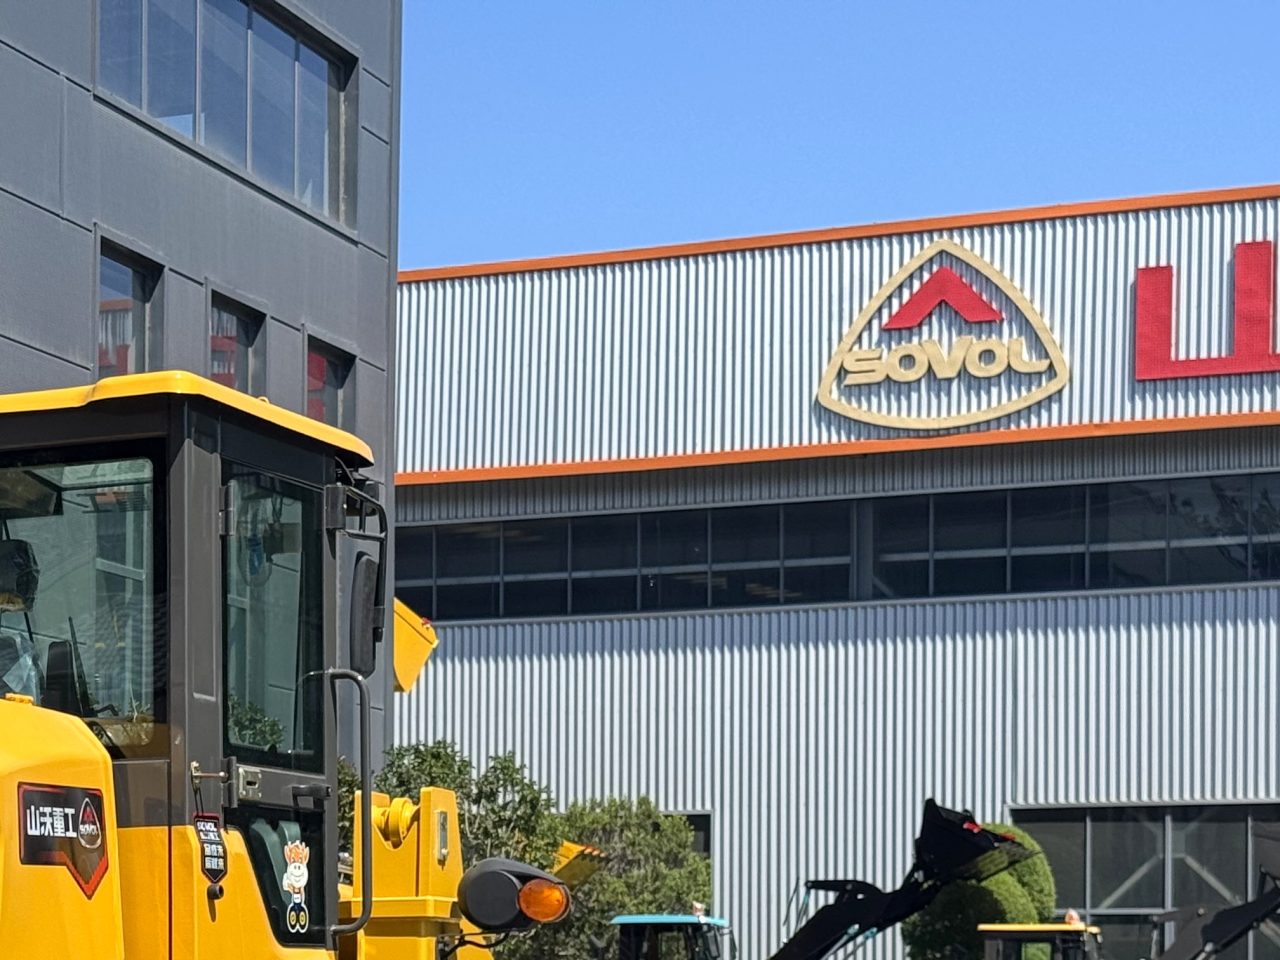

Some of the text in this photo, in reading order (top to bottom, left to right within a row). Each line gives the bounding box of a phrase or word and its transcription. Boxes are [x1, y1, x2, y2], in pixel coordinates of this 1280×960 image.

[841, 336, 1051, 386] SOVOL
[25, 805, 79, 839] 山沃重工
